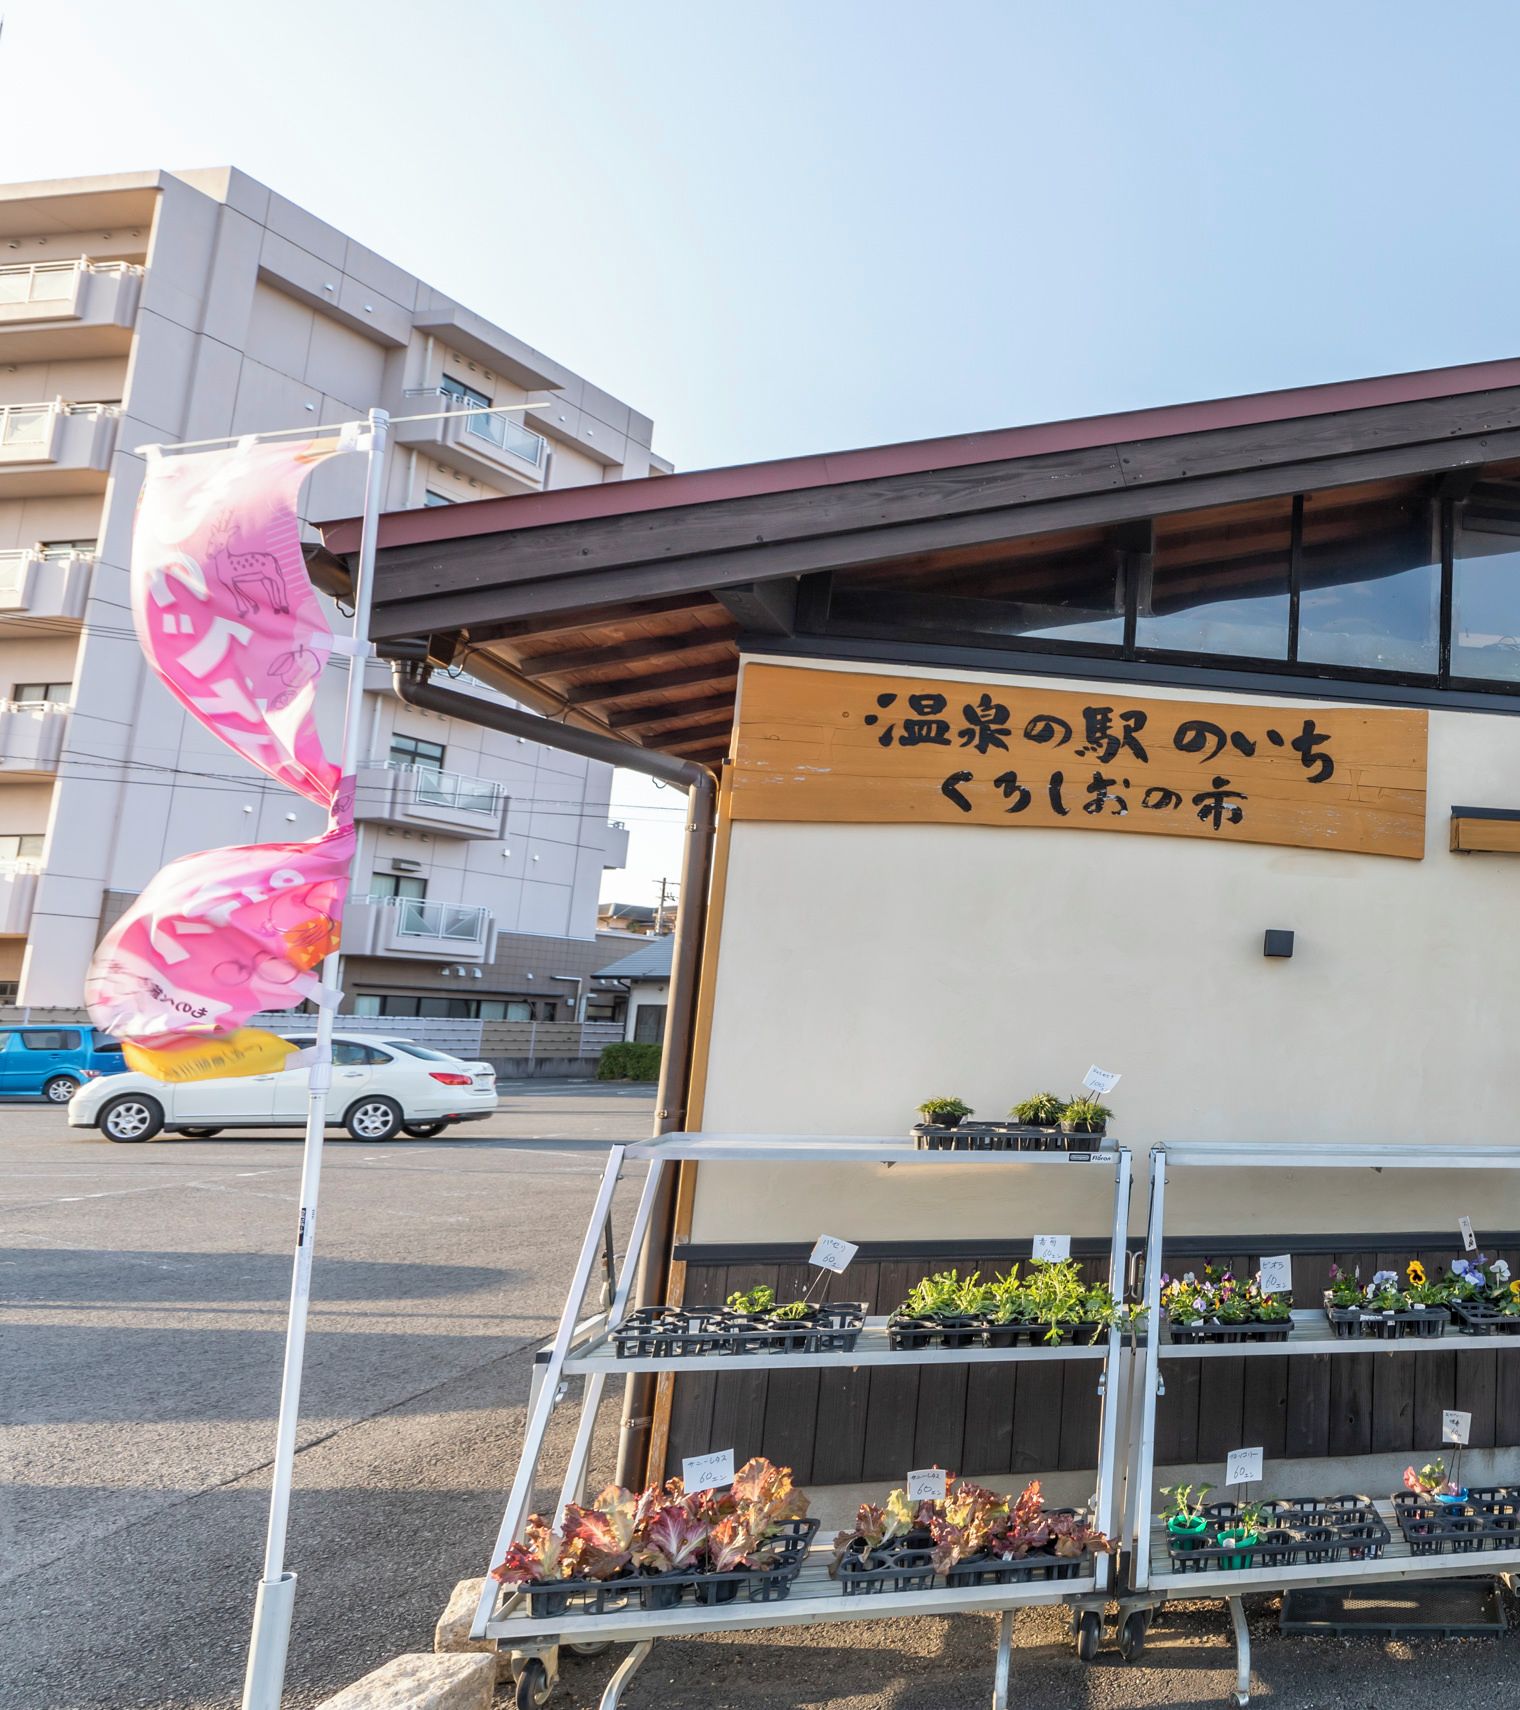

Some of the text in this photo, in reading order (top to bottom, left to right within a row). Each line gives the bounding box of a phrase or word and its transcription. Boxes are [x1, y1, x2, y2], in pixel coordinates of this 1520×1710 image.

[864, 693, 1335, 783] 温泉の駅 のいち
[941, 771, 1249, 831] くろしおの市
[1262, 1260, 1285, 1270] ビオラ
[687, 1454, 728, 1468] サニーレタス
[911, 1472, 942, 1480] サニーレタス
